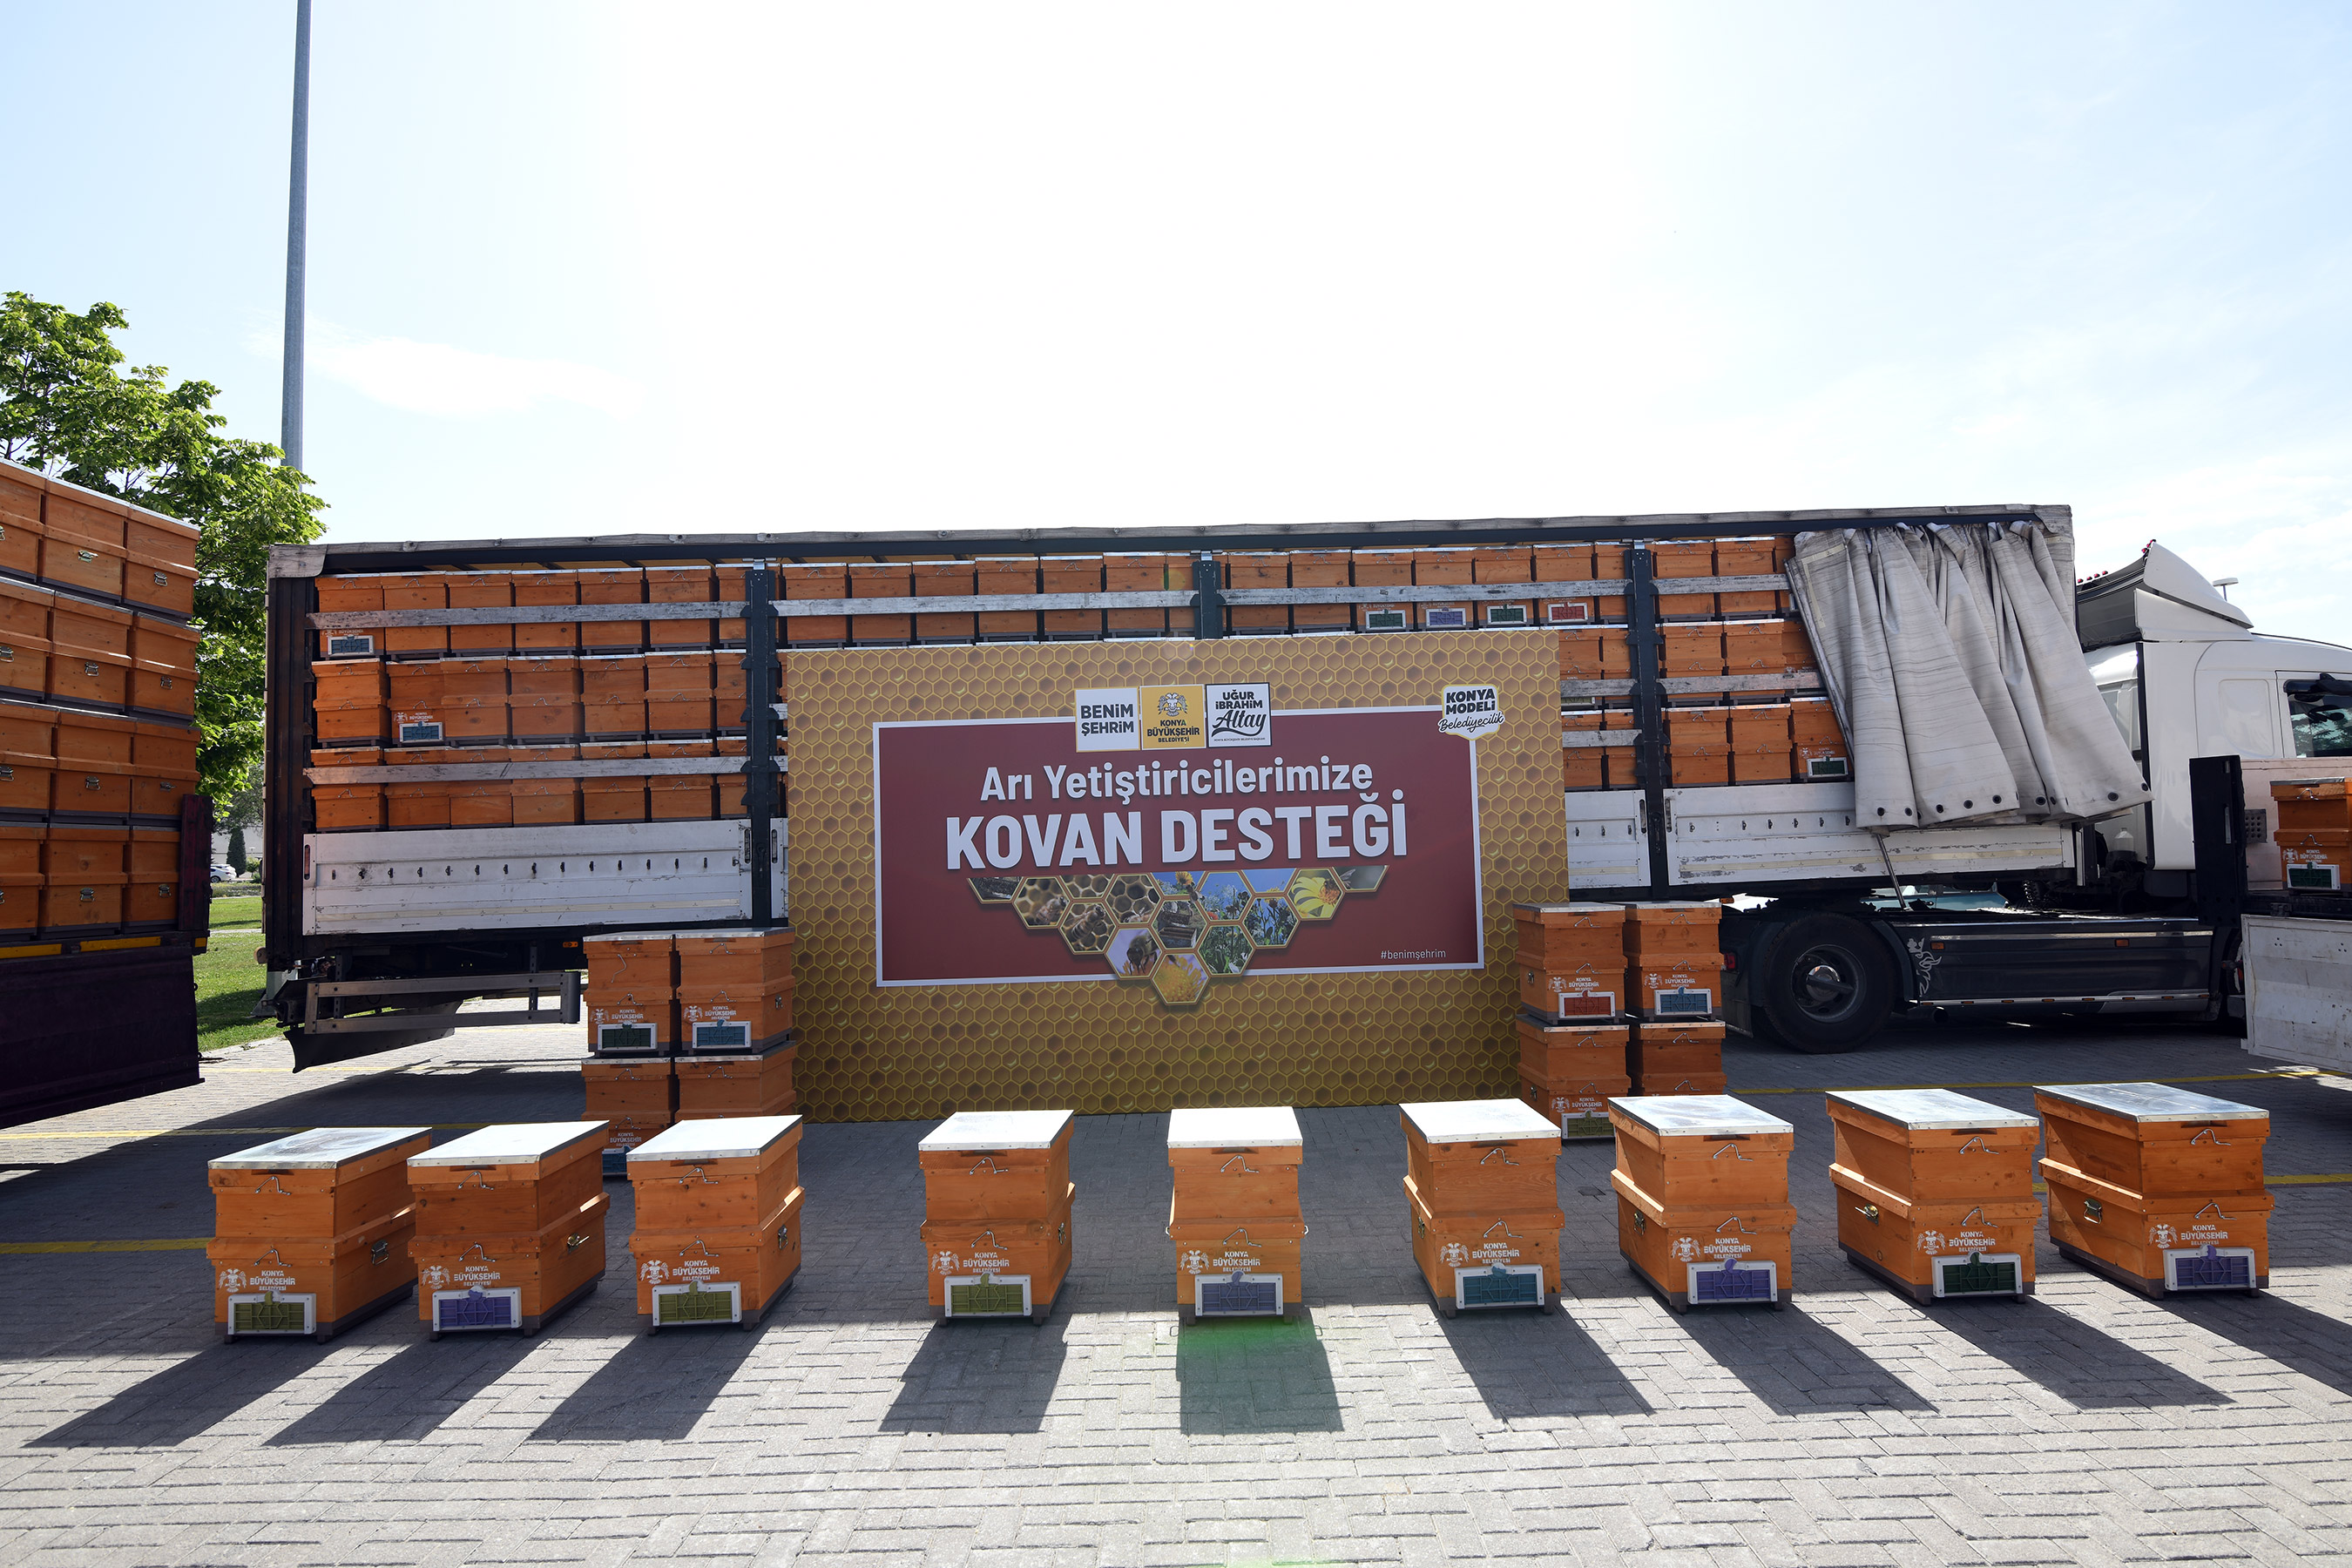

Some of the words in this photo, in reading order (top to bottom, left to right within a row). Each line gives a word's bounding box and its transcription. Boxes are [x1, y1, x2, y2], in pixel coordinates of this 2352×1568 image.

[1222, 689, 1254, 701] UĞUR
[1446, 689, 1495, 703] KONYA
[1212, 709, 1267, 737] Altay
[1439, 713, 1504, 733] Belediyecilik
[1147, 726, 1200, 737] BÜYÜKŞEHİR
[981, 767, 1032, 801] Arı
[1044, 755, 1373, 805] Yetiştiricilerimize
[946, 810, 1143, 870] KOVAN
[1160, 789, 1408, 863] DESTEĞİ
[1381, 949, 1446, 960] #benimşehrim
[2181, 1231, 2228, 1240] BÜYÜKŞEHİR
[1949, 1237, 1996, 1247] BÜYÜKŞEHİR
[1472, 1248, 1519, 1259] BÜYÜKŞEHİR
[1704, 1244, 1751, 1254] BÜYÜKŞEHİR
[963, 1258, 1010, 1267] BÜYÜKŞEHİR
[1213, 1257, 1260, 1267] BÜYÜKŞEHİR
[672, 1266, 720, 1275] BÜYÜKŞEHİR
[249, 1276, 295, 1286] BÜYÜKŞEHİR
[454, 1272, 500, 1281] BÜYÜKŞEHİR
